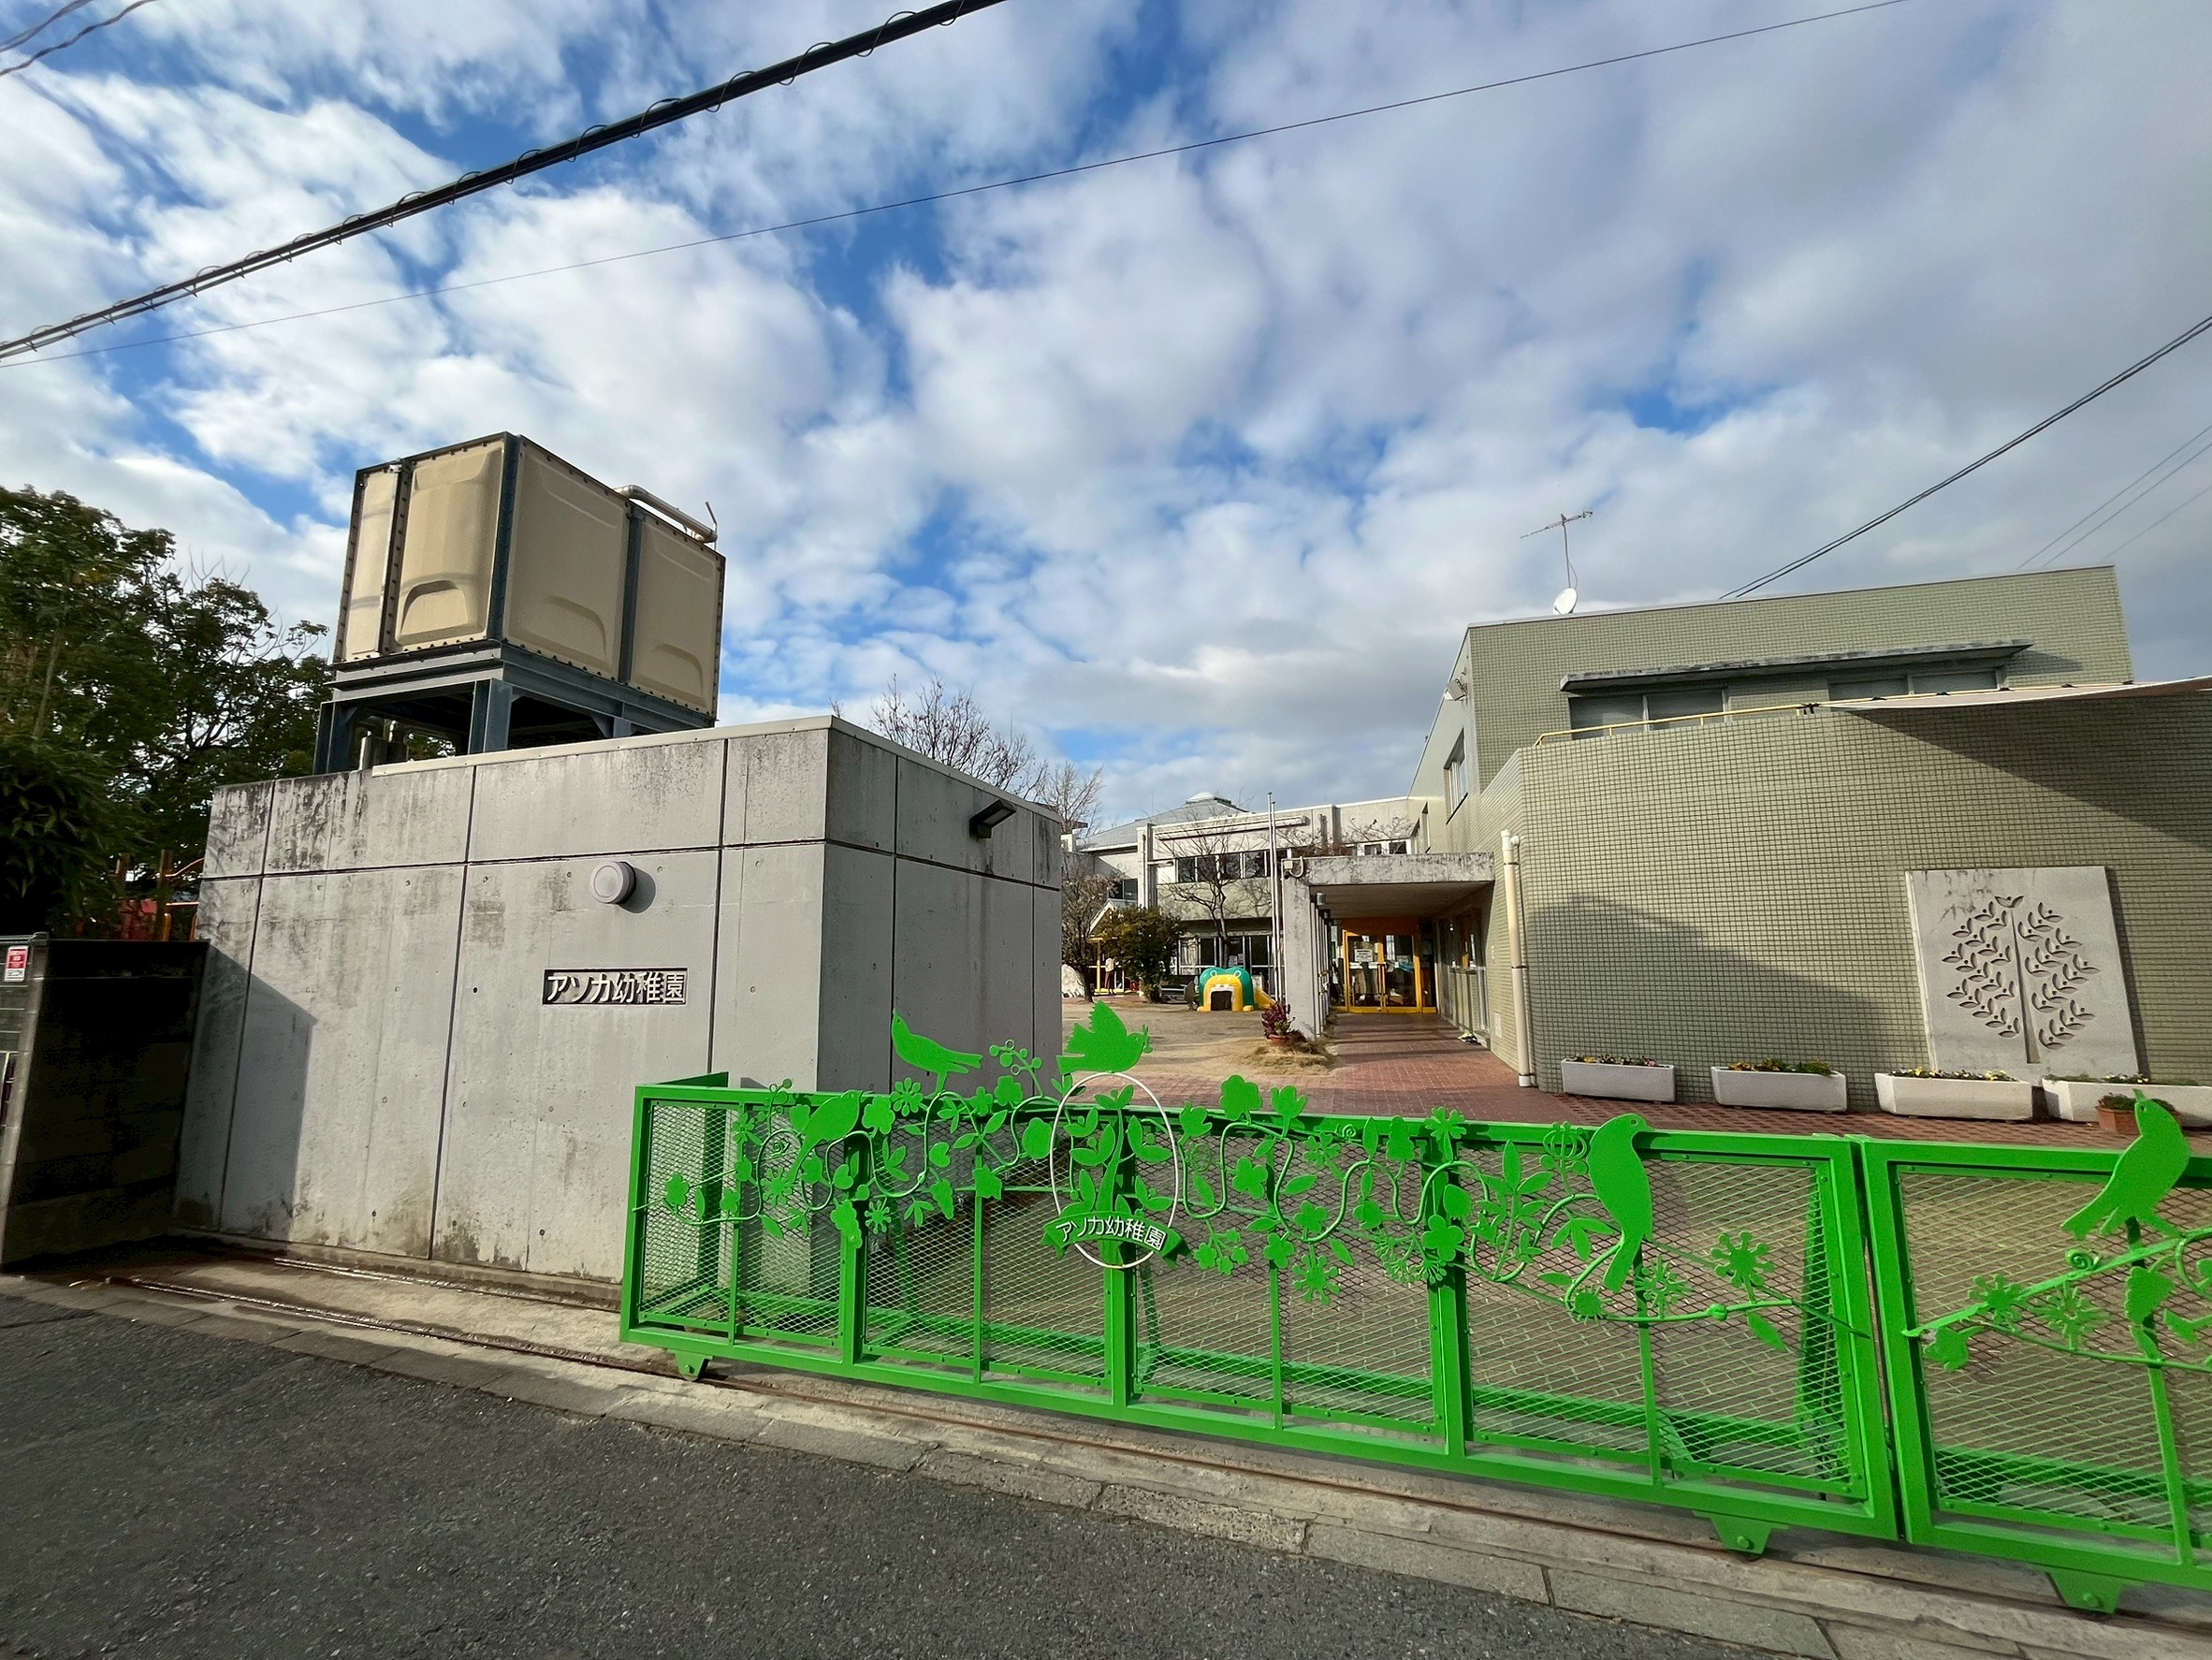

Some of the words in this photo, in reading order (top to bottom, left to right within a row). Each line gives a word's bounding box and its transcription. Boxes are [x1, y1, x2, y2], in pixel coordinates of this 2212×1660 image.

[546, 971, 686, 1003] アソカ幼稚園
[1055, 1215, 1167, 1251] アソカ幼稚園
